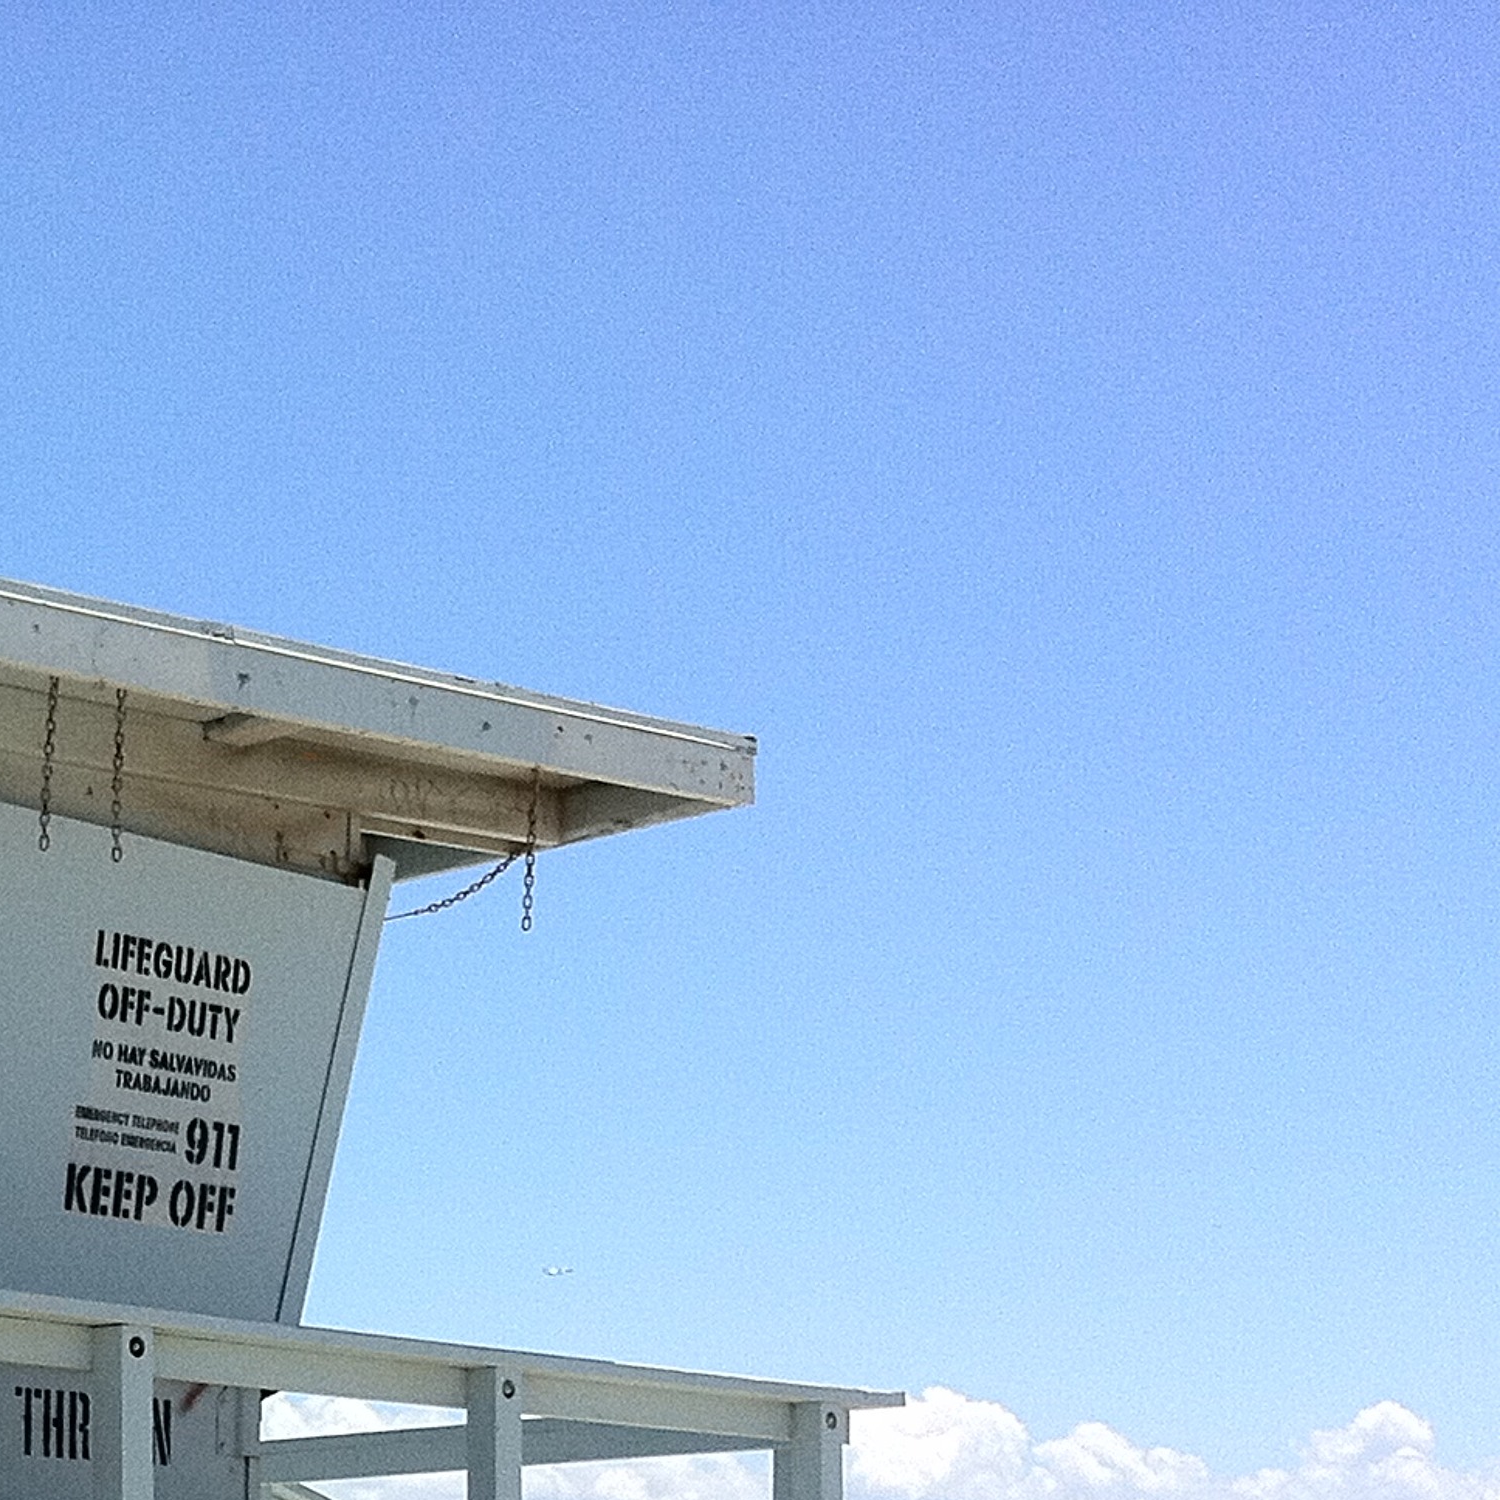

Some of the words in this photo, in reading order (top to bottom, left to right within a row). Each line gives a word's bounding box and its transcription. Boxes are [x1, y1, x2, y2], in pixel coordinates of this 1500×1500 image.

[95, 929, 251, 995] LIFEGUARD
[98, 983, 240, 1043] OFF-DUTY
[92, 1039, 113, 1060] NO
[118, 1044, 147, 1066] HAY
[150, 1048, 236, 1082] SALVAVIDAS
[115, 1069, 211, 1103] TRABAJANDO
[75, 1105, 130, 1126] EMERGENCY
[185, 1117, 240, 1171] 911
[64, 1163, 158, 1221] KEEP
[169, 1180, 235, 1233] OFF
